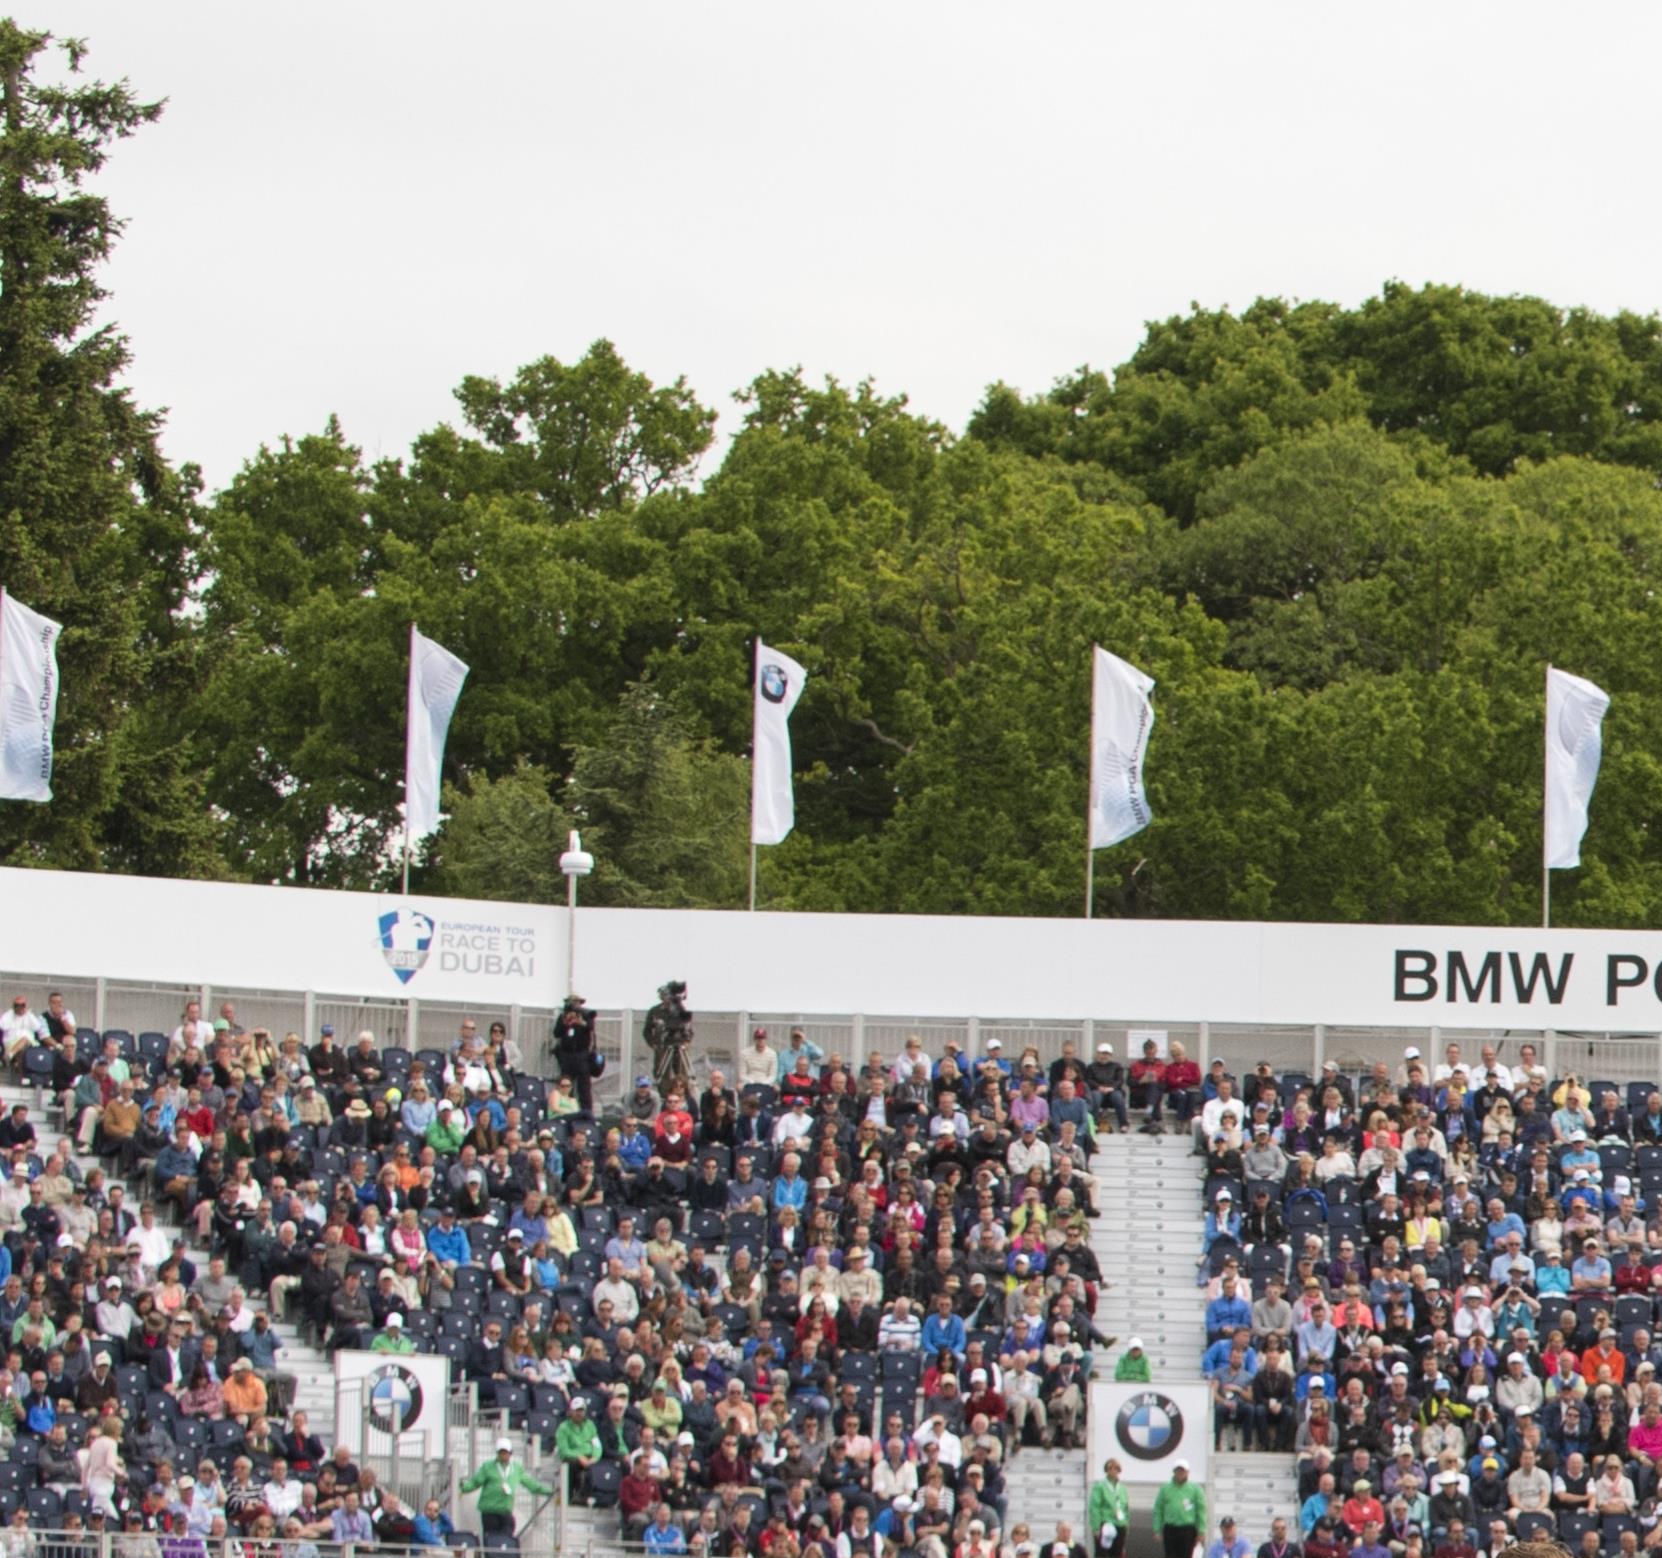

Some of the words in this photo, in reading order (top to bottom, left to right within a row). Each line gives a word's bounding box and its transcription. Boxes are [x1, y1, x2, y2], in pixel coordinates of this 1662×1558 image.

[440, 922, 500, 934] EUROPEAN
[506, 926, 535, 937] TOUR
[440, 932, 499, 951] RACE
[507, 938, 536, 954] TO
[440, 951, 535, 977] DUBAI
[1393, 949, 1575, 1005] BMW
